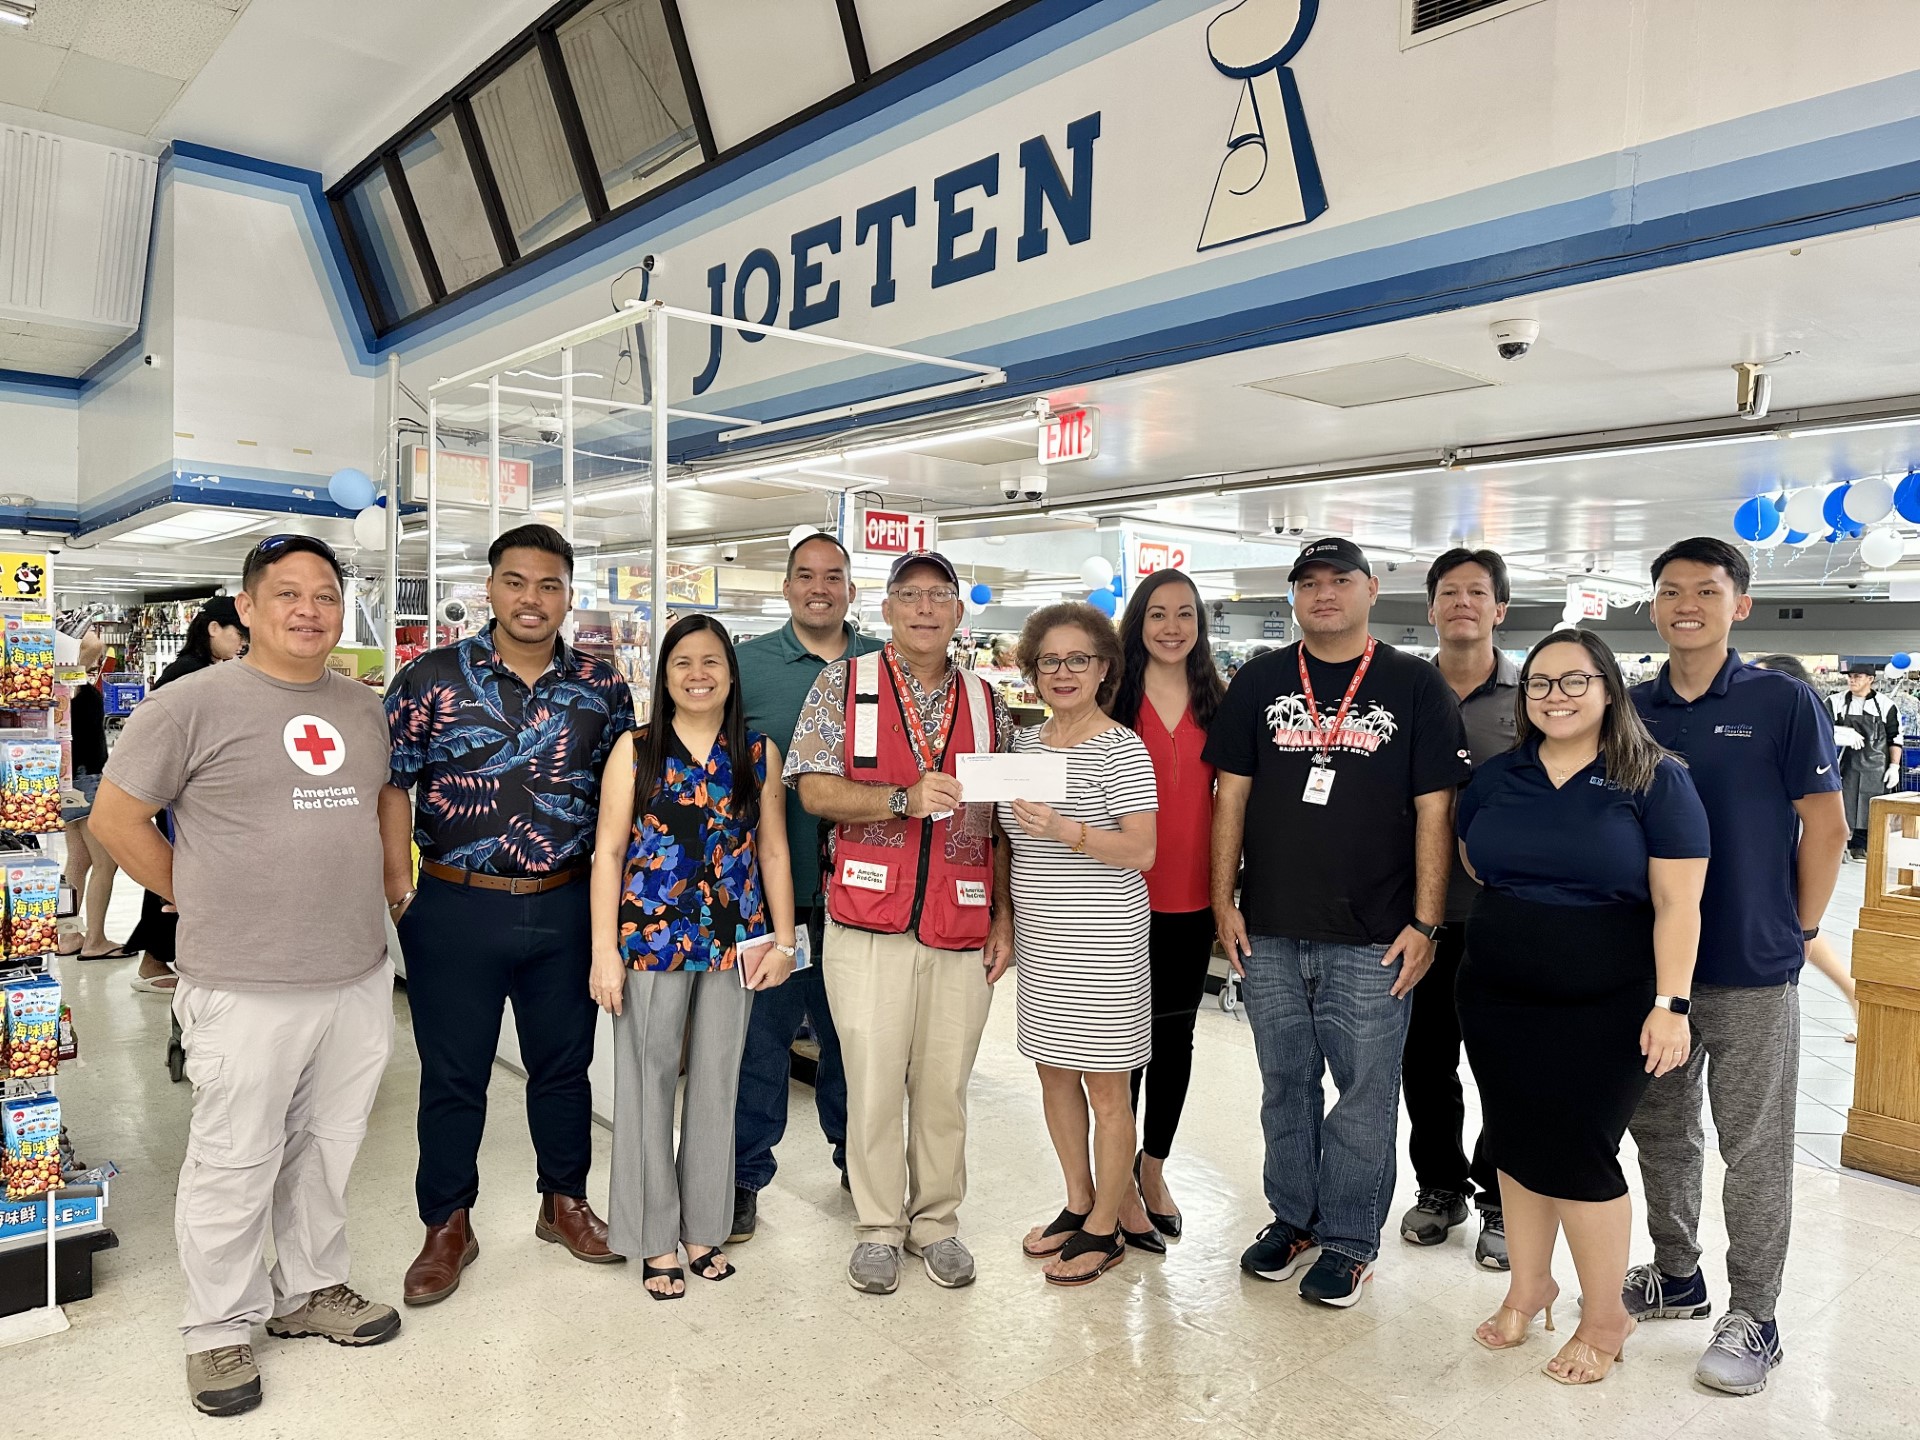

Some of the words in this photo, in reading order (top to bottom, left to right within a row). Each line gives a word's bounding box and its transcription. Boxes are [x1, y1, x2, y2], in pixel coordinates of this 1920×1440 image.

[693, 111, 1101, 395] JOETEN
[1047, 409, 1087, 459] EXIT
[484, 460, 516, 484] LNE
[867, 517, 906, 547] OPEN
[913, 519, 925, 553] 1
[1139, 546, 1167, 572] OPEN
[1171, 549, 1185, 569] 2
[1596, 598, 1603, 616] 5
[1319, 715, 1353, 729] 203
[1275, 727, 1380, 752] WALKTHON
[292, 786, 356, 798] American
[293, 799, 322, 810] Red
[323, 797, 360, 808] Cross
[857, 868, 884, 877] American
[867, 876, 883, 884] Cross
